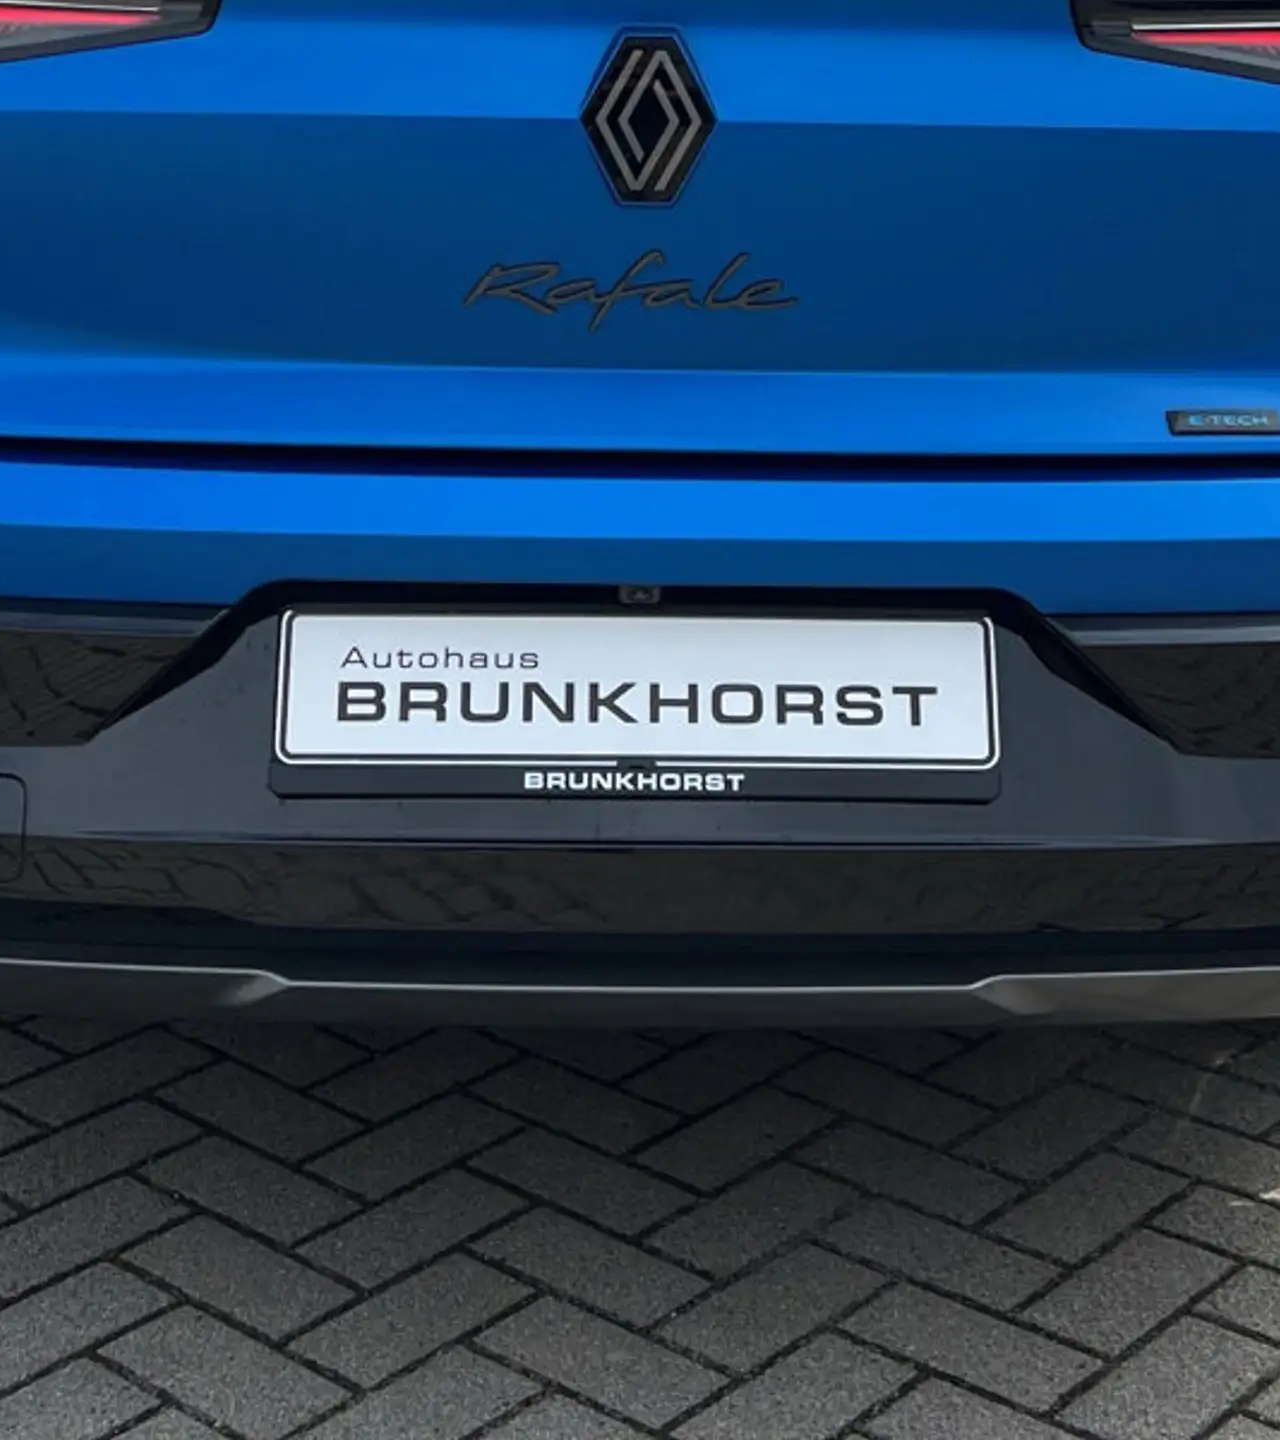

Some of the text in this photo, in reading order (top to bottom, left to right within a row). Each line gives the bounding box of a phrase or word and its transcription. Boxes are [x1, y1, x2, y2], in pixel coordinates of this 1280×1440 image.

[463, 249, 799, 332] Rafale
[340, 647, 540, 669] Autohaus
[337, 681, 938, 727] BRUNKHORST
[523, 771, 745, 792] BRUNKHORST
